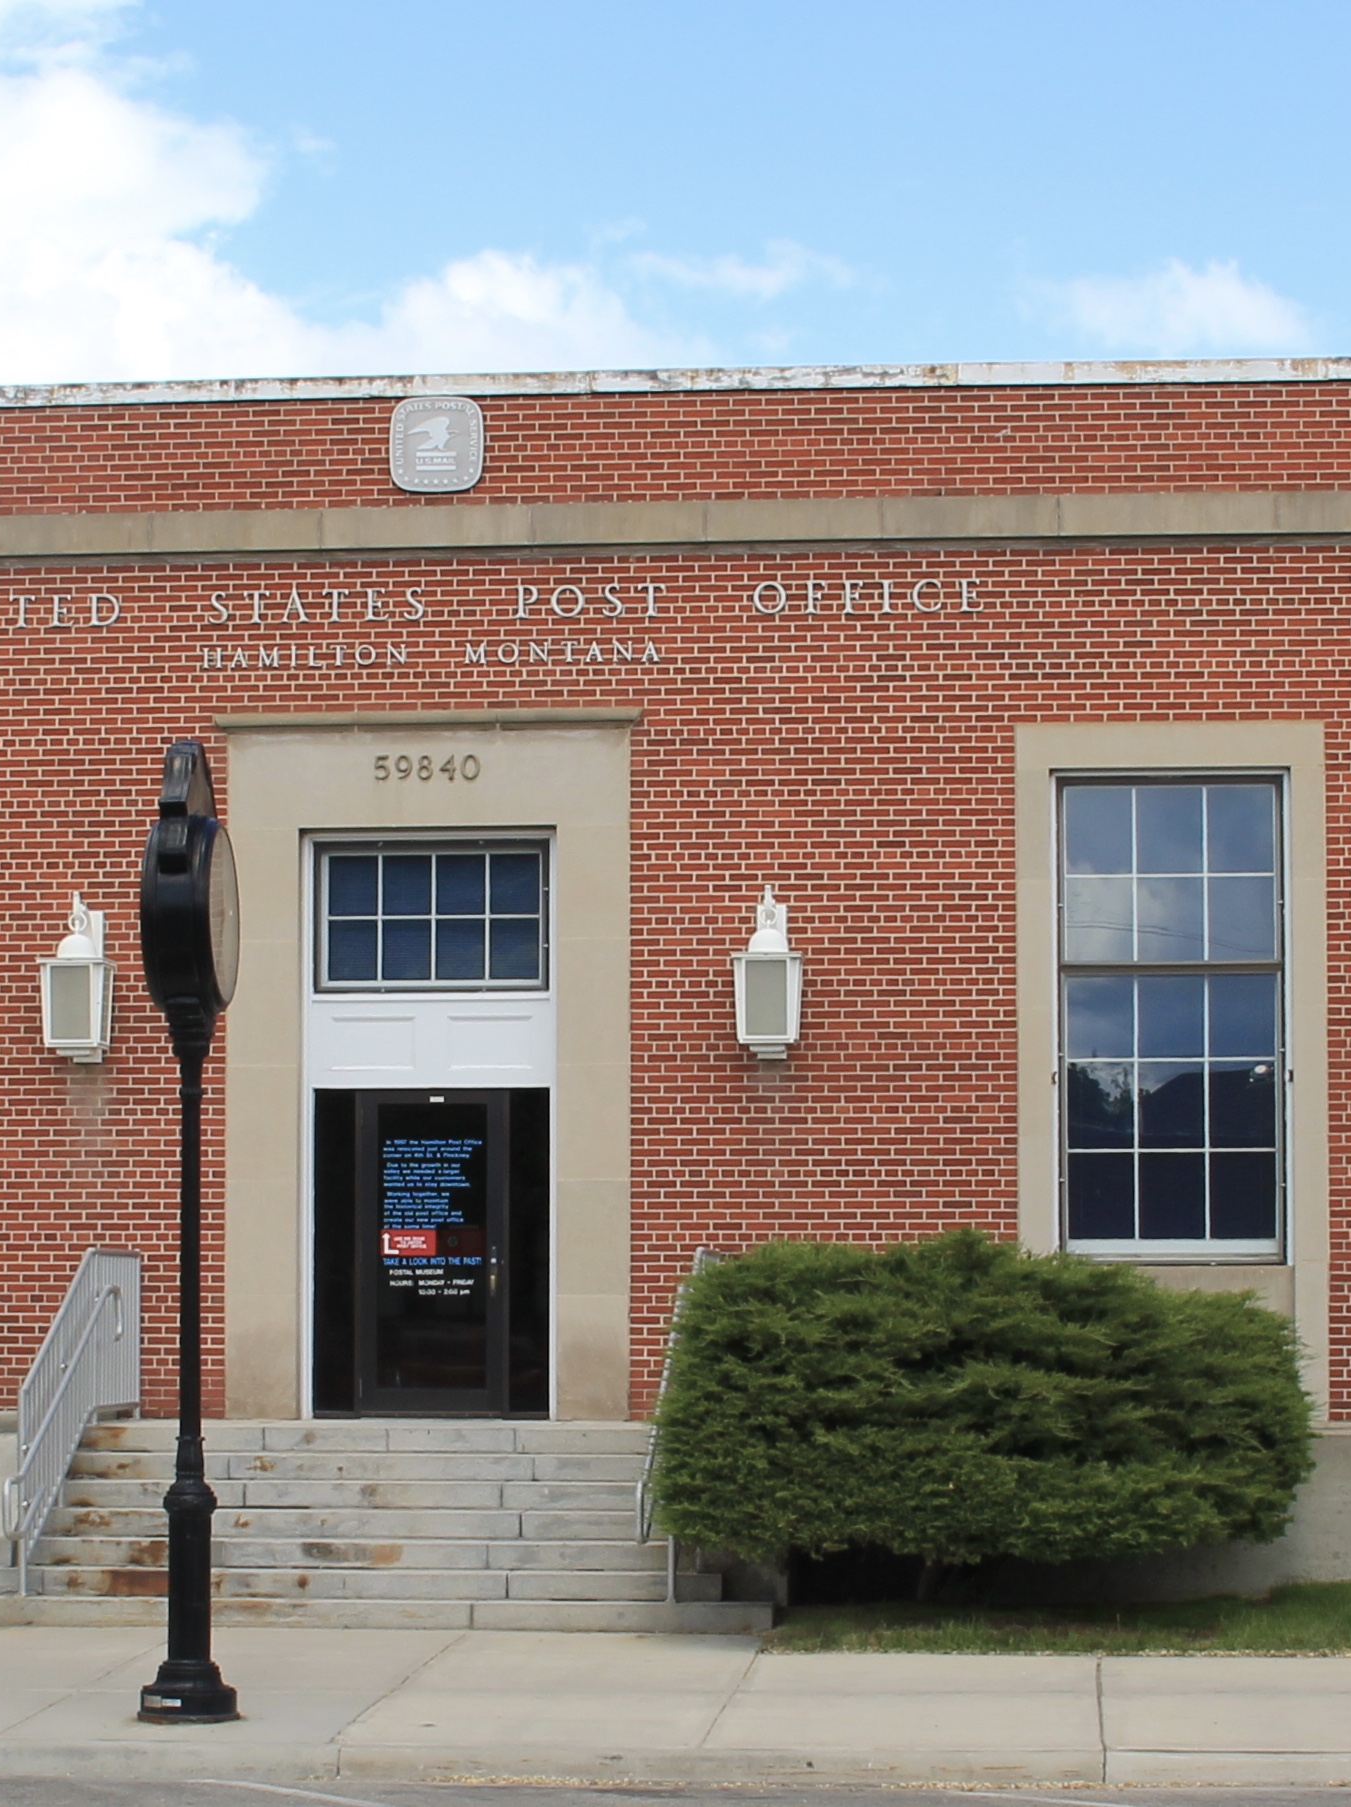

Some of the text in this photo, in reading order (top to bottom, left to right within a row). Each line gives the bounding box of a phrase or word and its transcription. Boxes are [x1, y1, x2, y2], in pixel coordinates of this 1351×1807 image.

[395, 401, 478, 465] UNITED STATES POSTAL SERVICE
[208, 586, 425, 625] STATES
[513, 583, 666, 619] POST
[752, 578, 984, 614] OFFICE
[202, 640, 661, 669] HAMILTON MONTANA
[374, 754, 480, 781] 59840
[383, 1256, 399, 1265] TAKE
[402, 1256, 407, 1265] A
[409, 1256, 428, 1265] LOOK
[430, 1256, 446, 1265] INTO
[448, 1256, 461, 1265] THE
